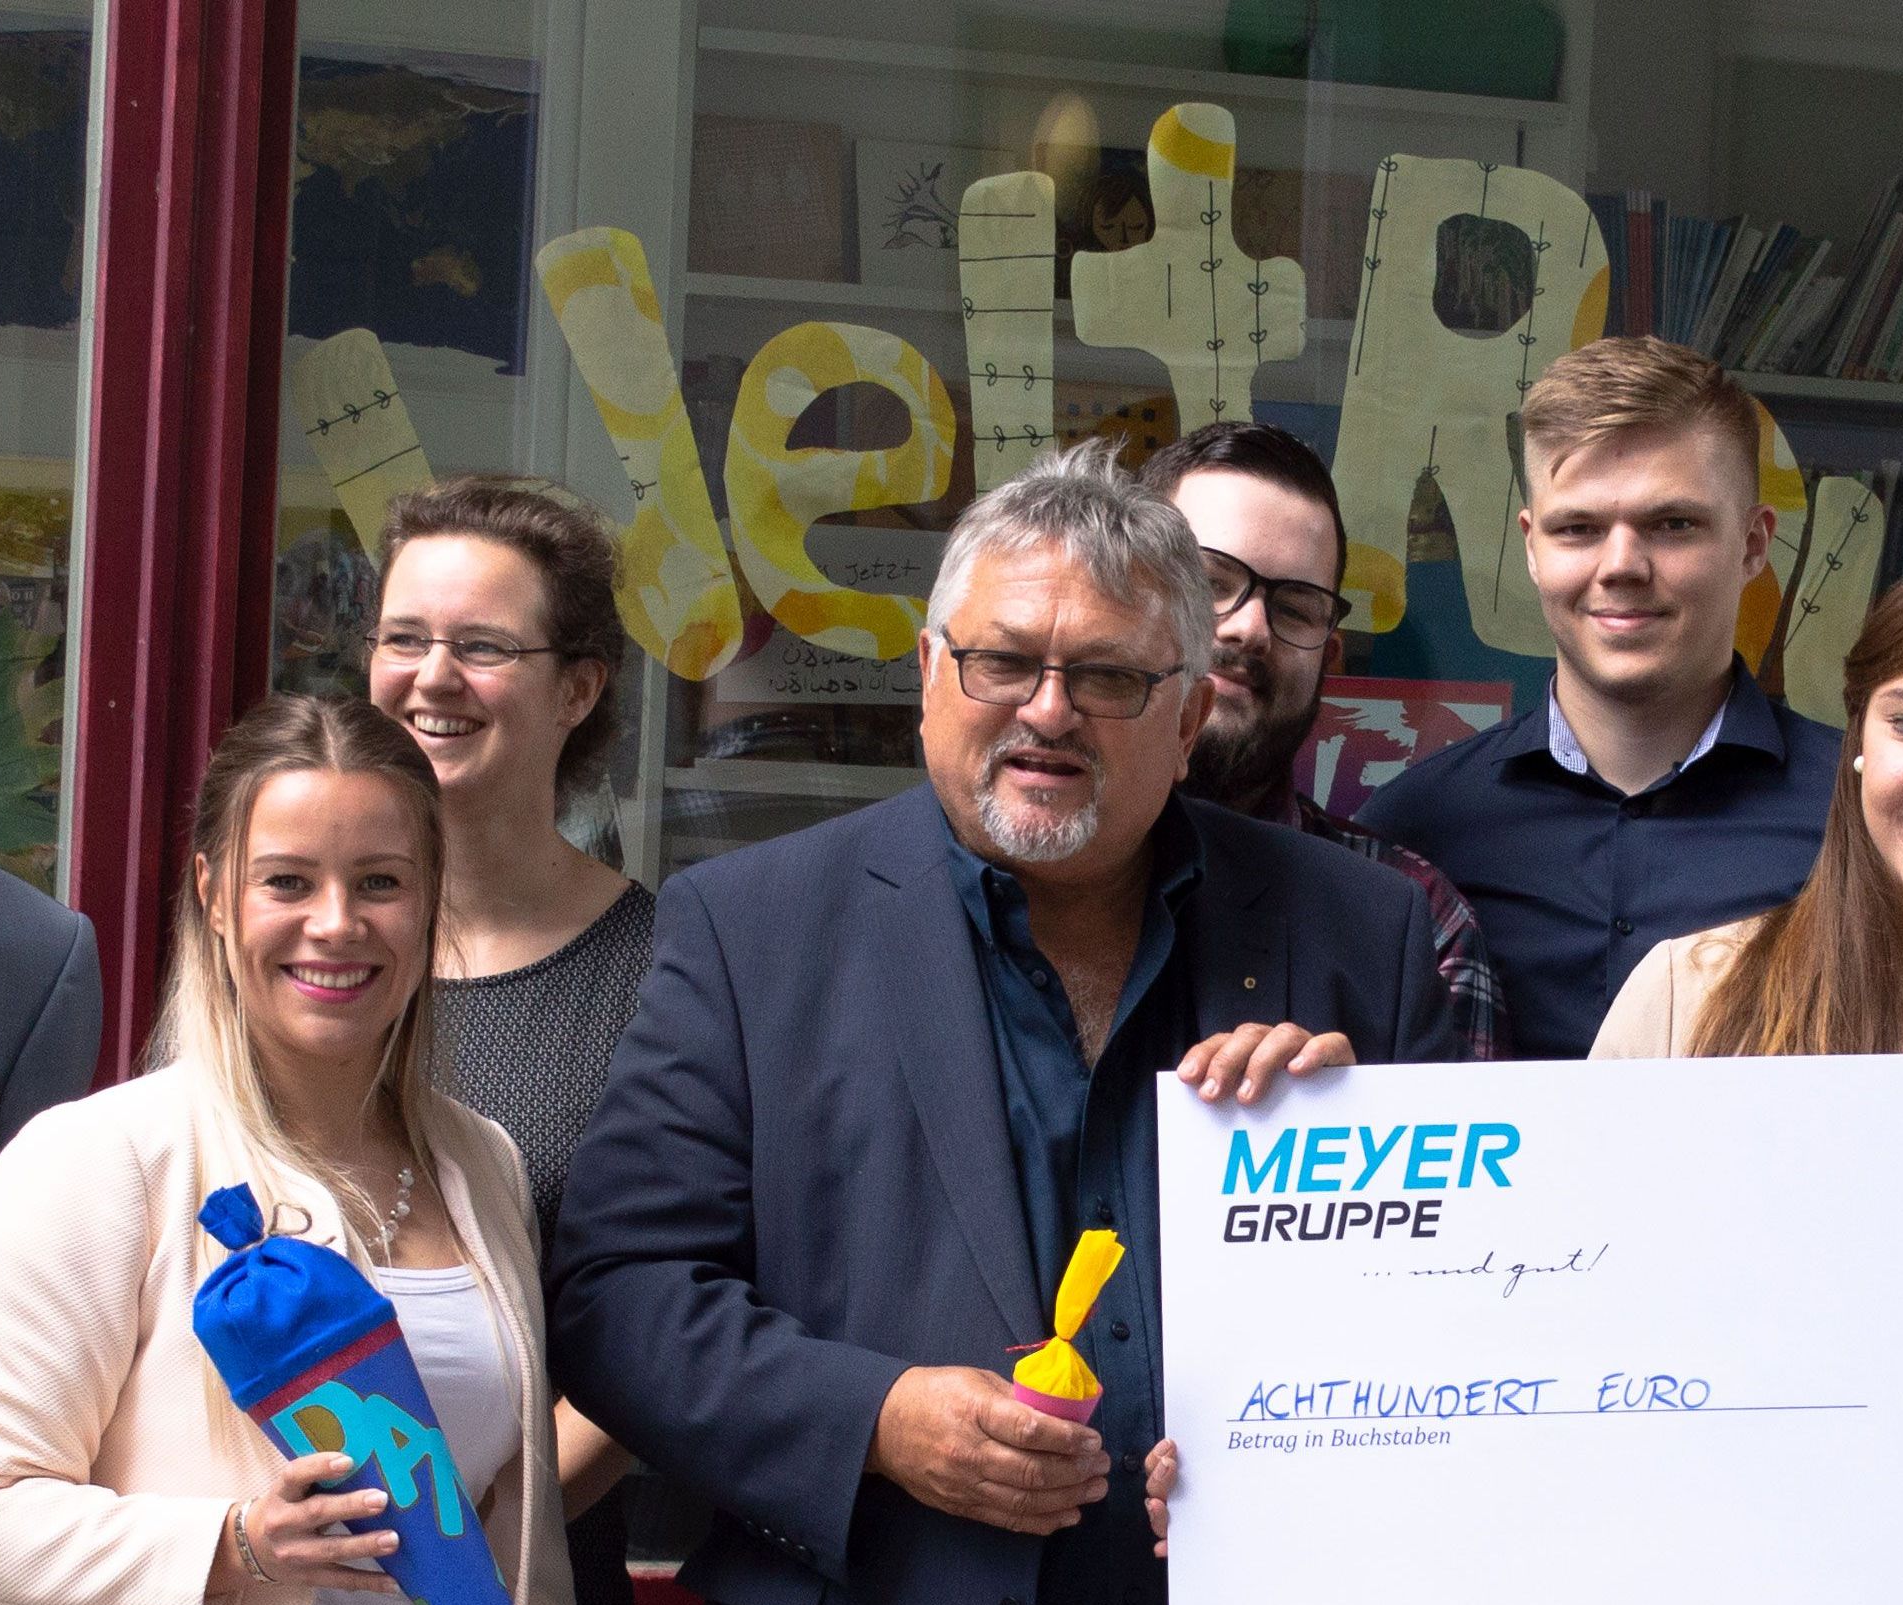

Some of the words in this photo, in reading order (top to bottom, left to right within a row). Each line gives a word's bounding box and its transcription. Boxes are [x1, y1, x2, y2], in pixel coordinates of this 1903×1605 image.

[1222, 1122, 1520, 1195] MEYER
[1223, 1199, 1442, 1243] GRUPPE
[1408, 1251, 1495, 1276] und
[1505, 1243, 1610, 1299] gut!
[1240, 1377, 1558, 1422] ACHTHUNDERT
[1597, 1372, 1712, 1413] EURO
[1228, 1430, 1298, 1454] Betrag
[1304, 1430, 1324, 1448] in
[1330, 1426, 1452, 1448] Buchstaben
